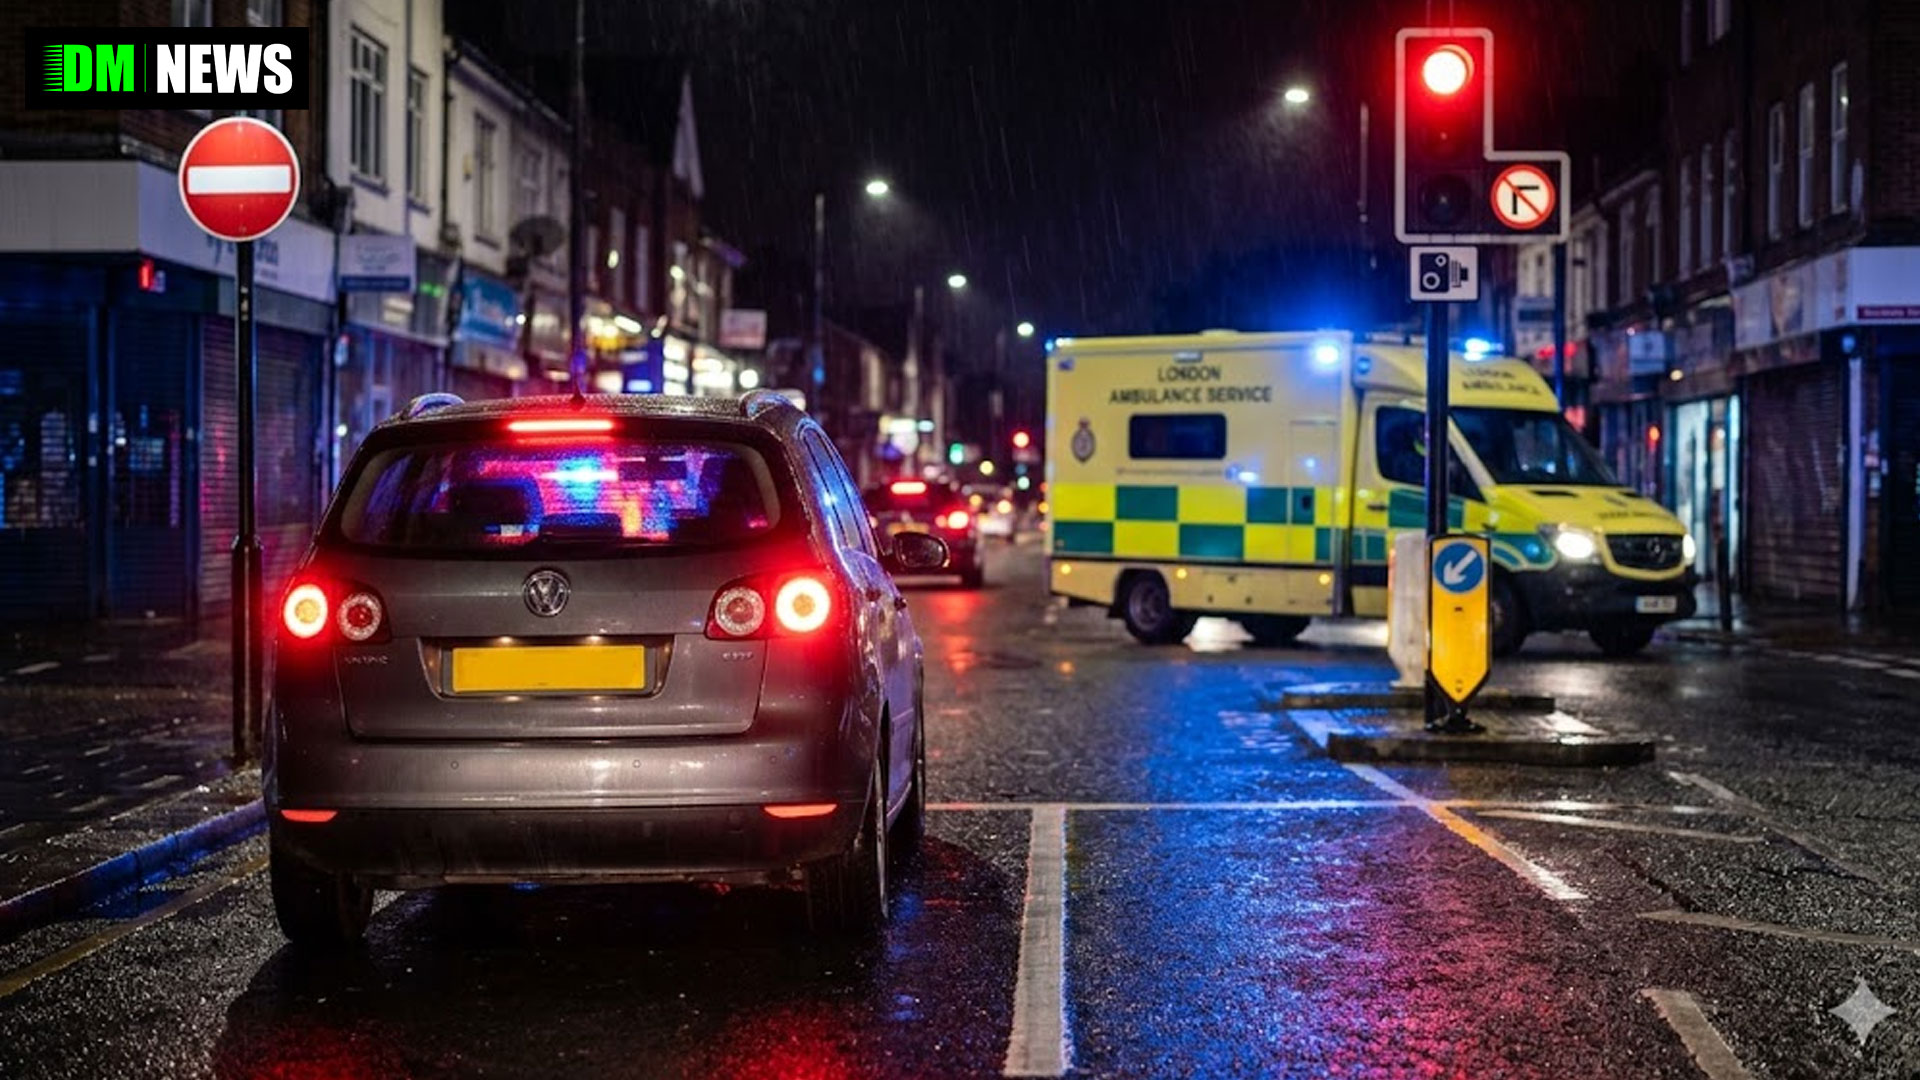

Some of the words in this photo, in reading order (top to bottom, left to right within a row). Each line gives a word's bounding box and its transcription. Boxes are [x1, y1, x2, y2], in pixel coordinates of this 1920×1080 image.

[1157, 366, 1221, 382] LONDON
[1109, 387, 1201, 404] AMBULANCE
[1207, 386, 1272, 403] SERVICE
